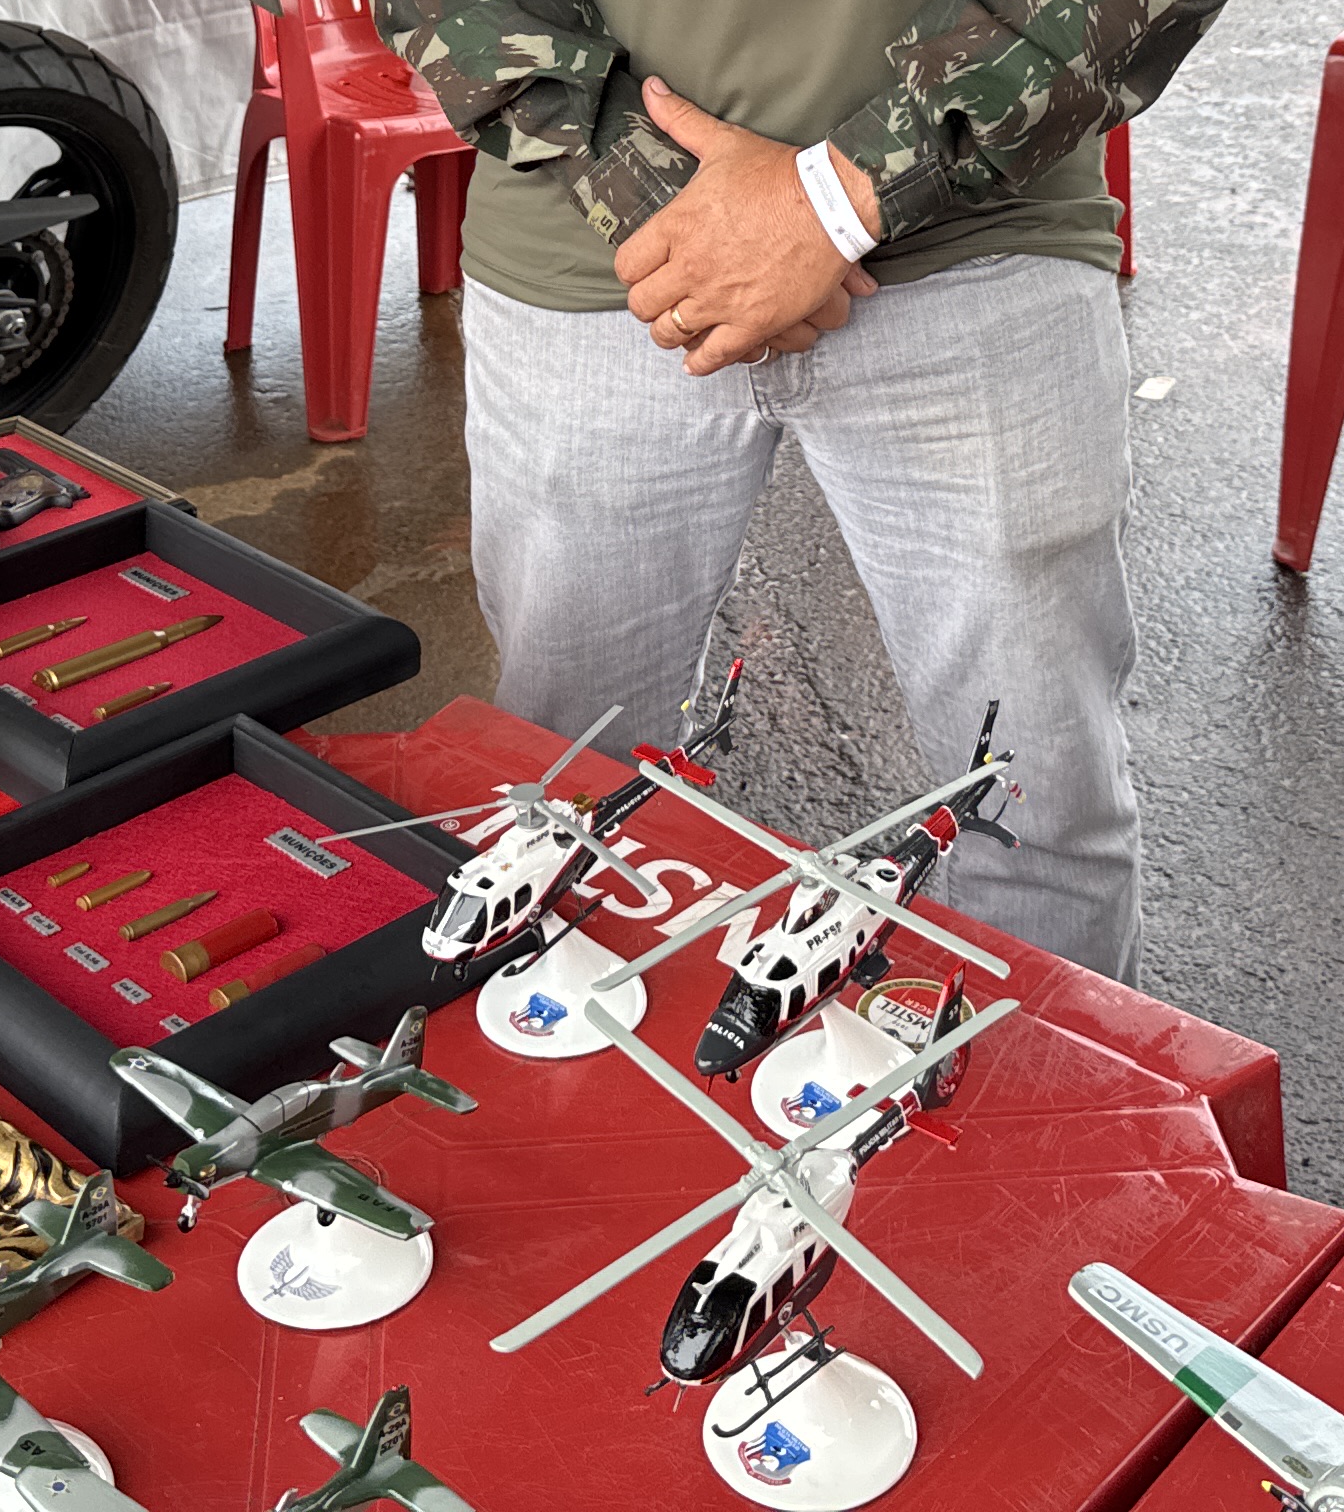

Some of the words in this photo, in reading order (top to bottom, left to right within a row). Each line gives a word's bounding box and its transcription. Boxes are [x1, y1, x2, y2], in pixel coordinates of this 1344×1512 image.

[130, 570, 179, 595] MUNIÇÕES
[278, 833, 337, 870] MUNIÇÕES
[805, 920, 843, 951] PR-FSP
[119, 981, 134, 992] Cal
[131, 989, 142, 998] 12
[878, 998, 933, 1031] MSTEL
[904, 997, 936, 1016] AGER
[82, 1199, 110, 1221] A-29A
[357, 1193, 396, 1212] FAB
[85, 1212, 108, 1231] 5701
[1096, 1284, 1190, 1354] USMC
[378, 1417, 407, 1439] A-29A
